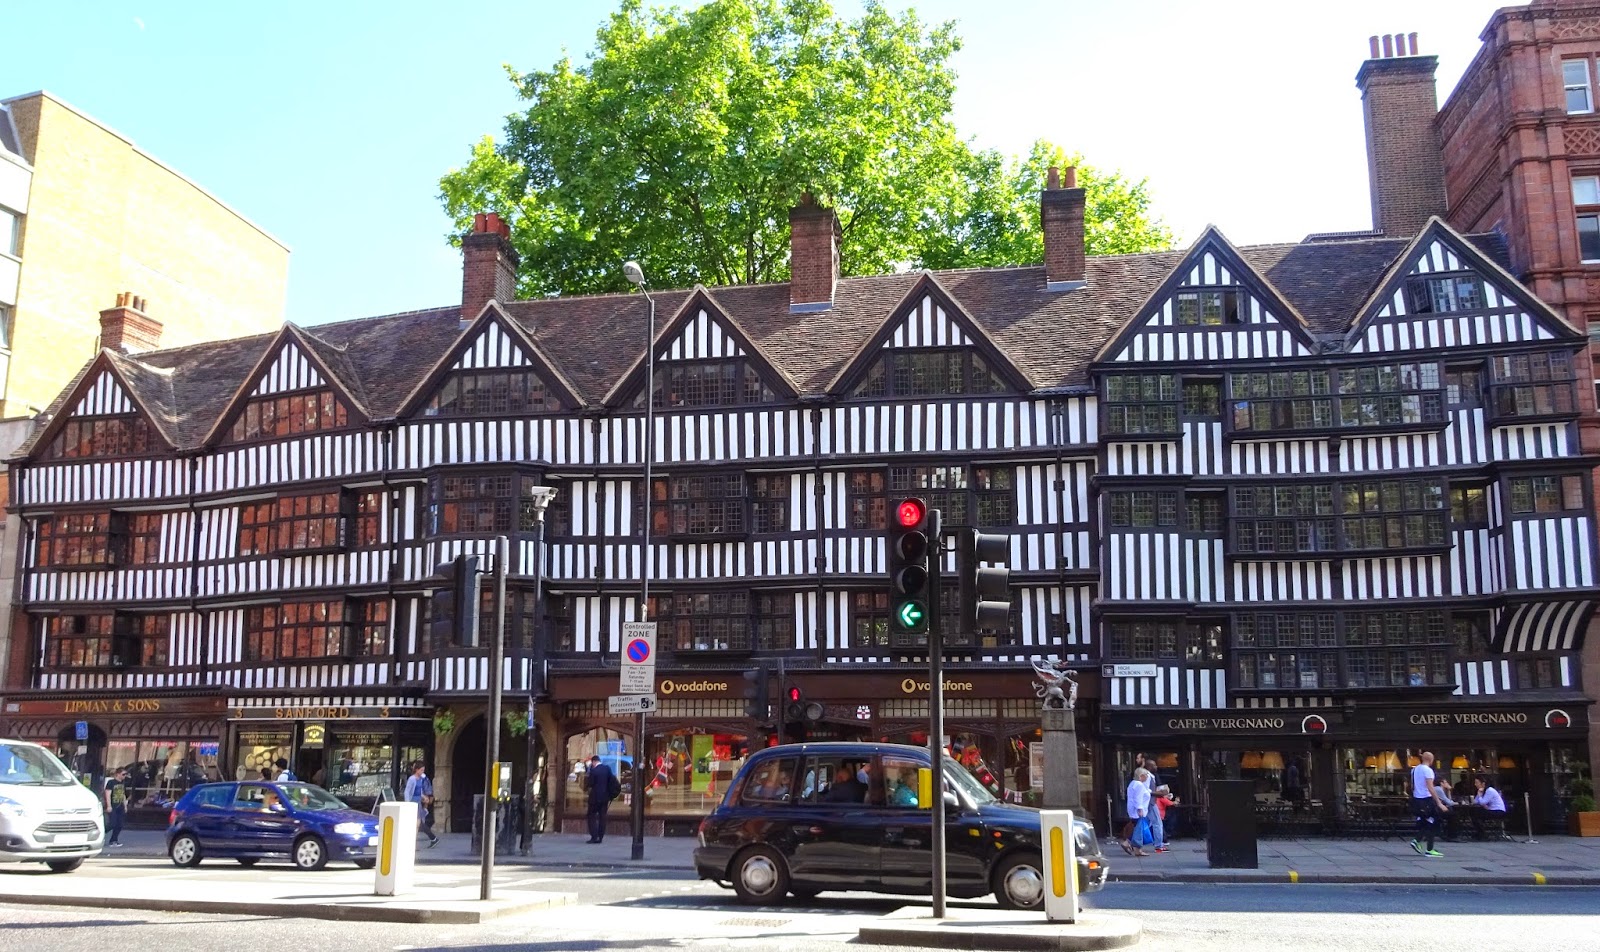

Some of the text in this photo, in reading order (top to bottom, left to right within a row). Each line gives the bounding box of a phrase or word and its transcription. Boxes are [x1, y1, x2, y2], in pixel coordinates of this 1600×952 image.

[675, 681, 728, 692] vodafone
[916, 680, 973, 691] voafone
[64, 700, 160, 712] LIPMAN & SONS
[234, 708, 243, 718] 3
[276, 707, 350, 718] SANFORD
[380, 706, 390, 718] 3
[1168, 718, 1284, 730] CAFFE' VERGNANO
[1410, 712, 1528, 725] CAFFE' VERGNANO
